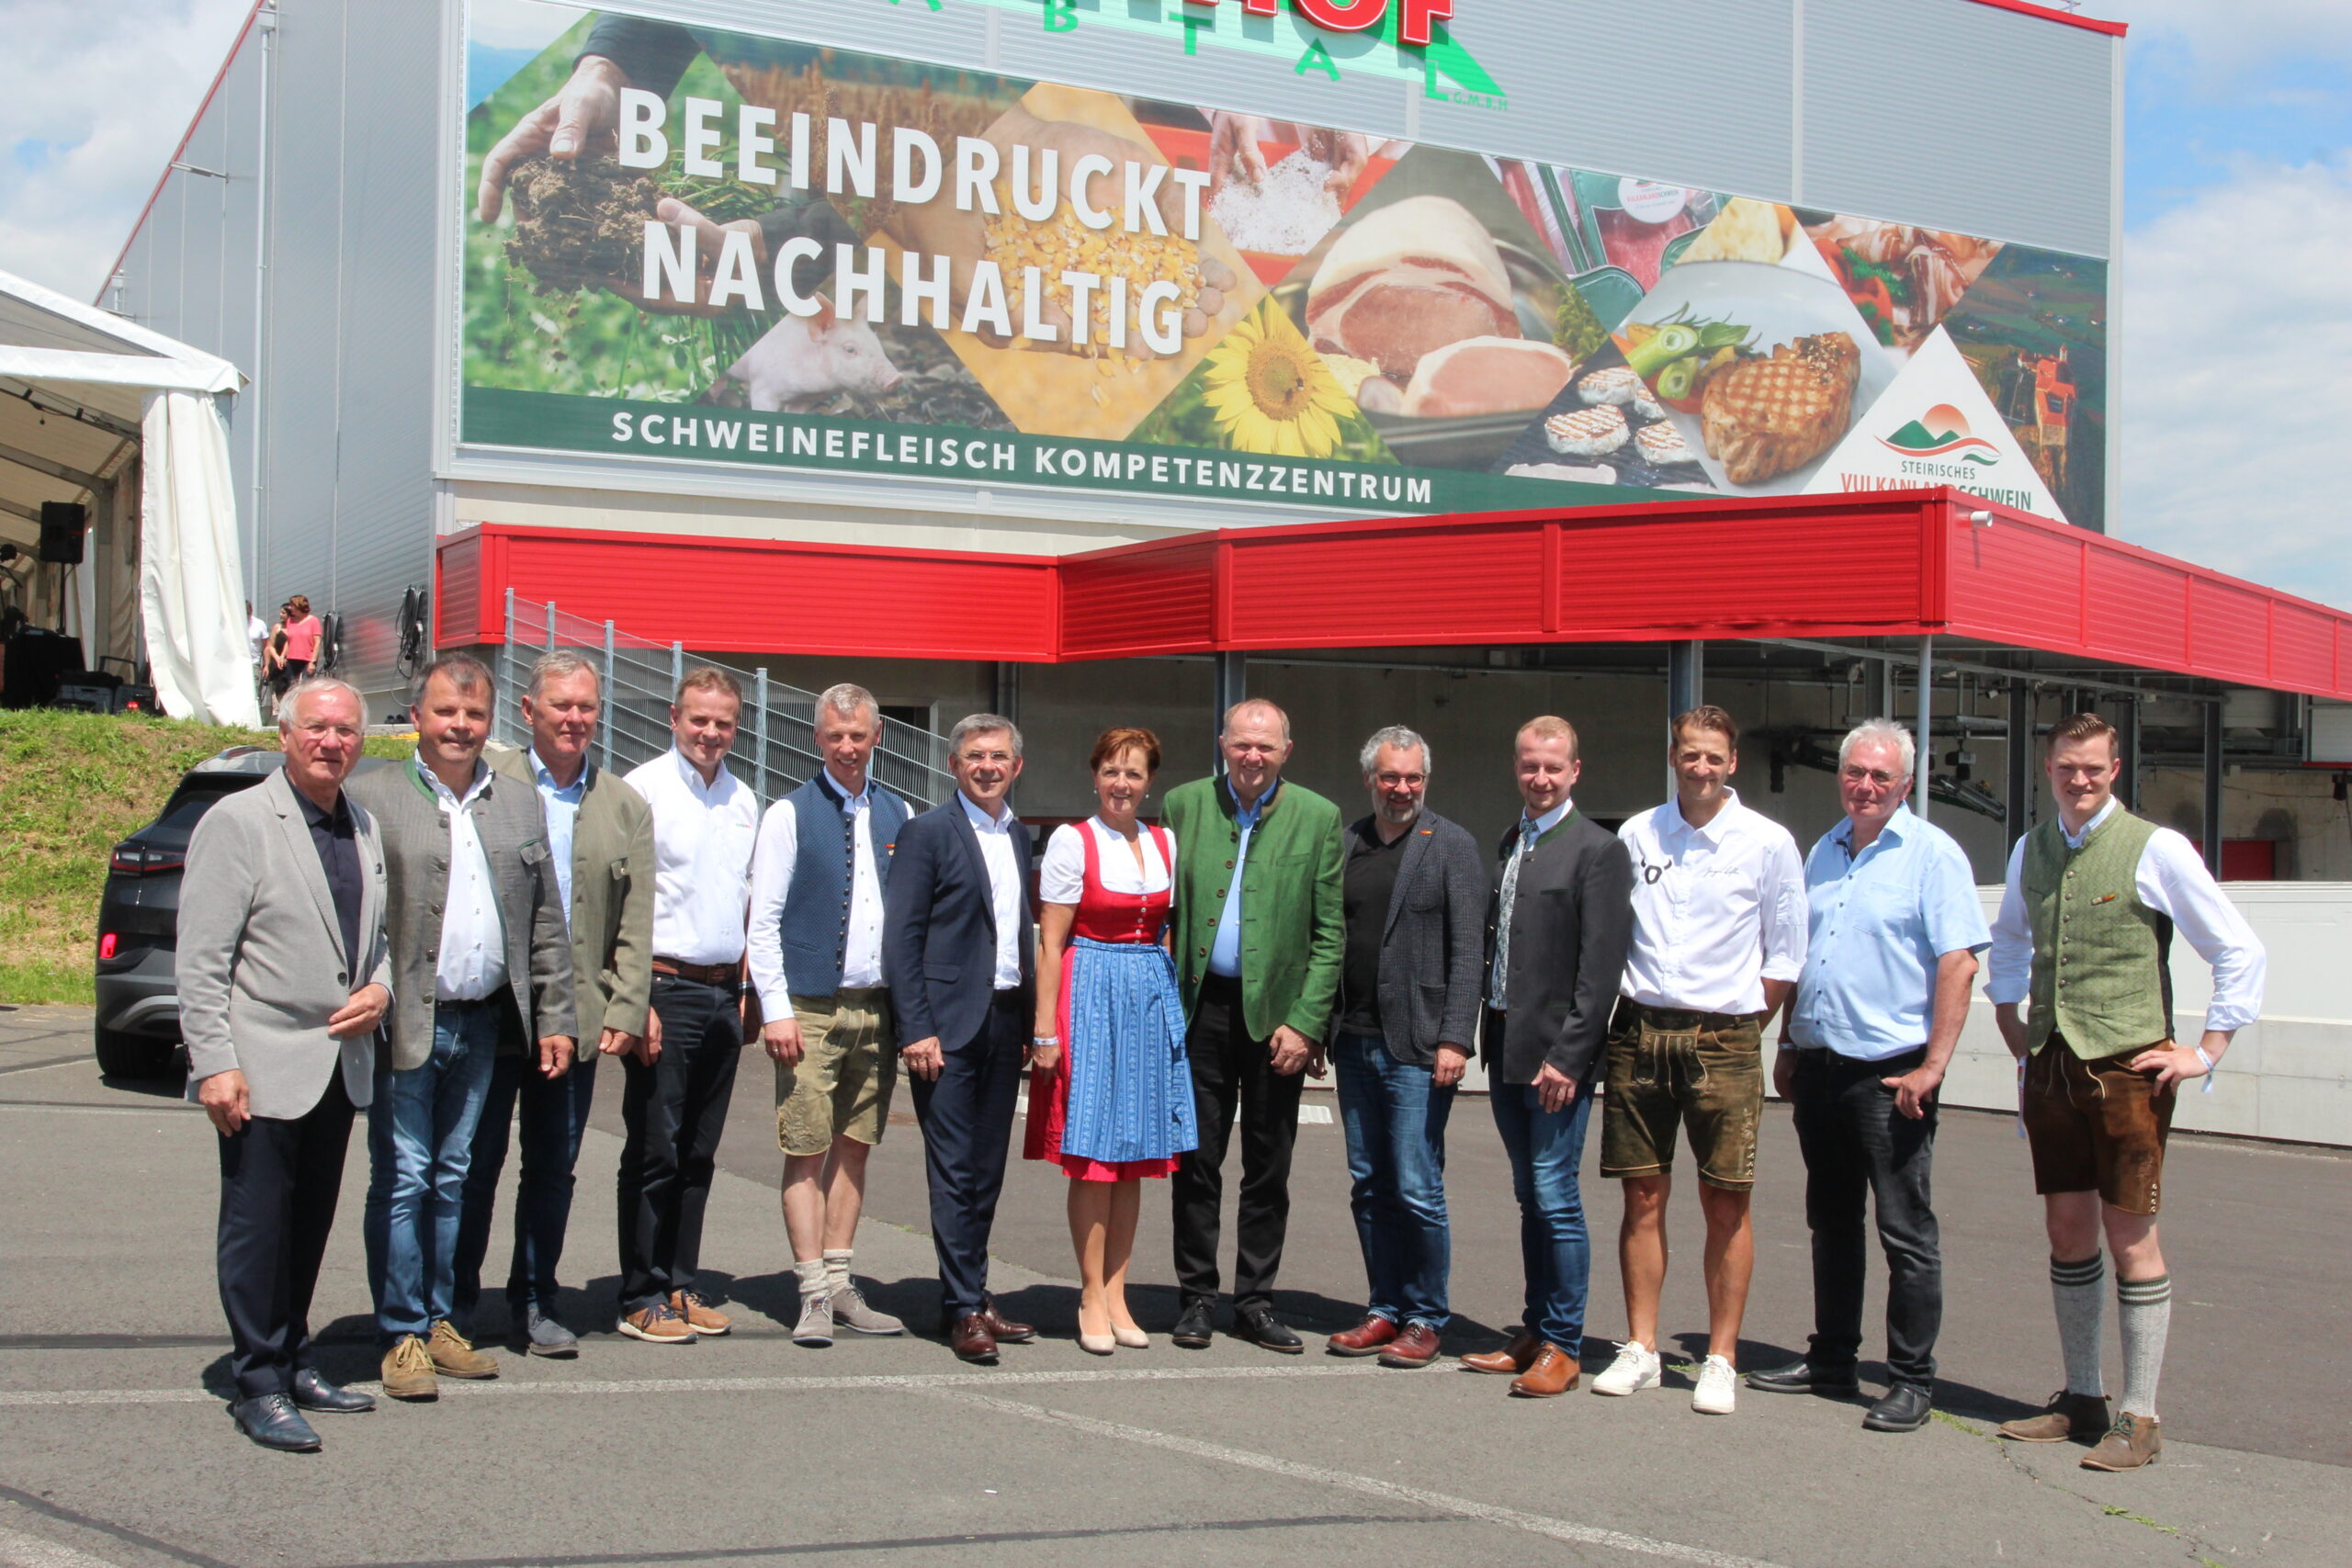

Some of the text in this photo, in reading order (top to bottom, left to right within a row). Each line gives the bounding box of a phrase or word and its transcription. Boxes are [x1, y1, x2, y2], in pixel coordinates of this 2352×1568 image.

[618, 86, 1211, 241] BEEINDRUCKT
[643, 220, 1183, 355] NACHHALTIG
[612, 412, 1431, 503] SCHWEINEFLEISCH KOMPETENZZENTRUM
[1840, 472, 2031, 511] VULKANCHWEIN
[1901, 460, 1975, 479] STEIRISCHES
